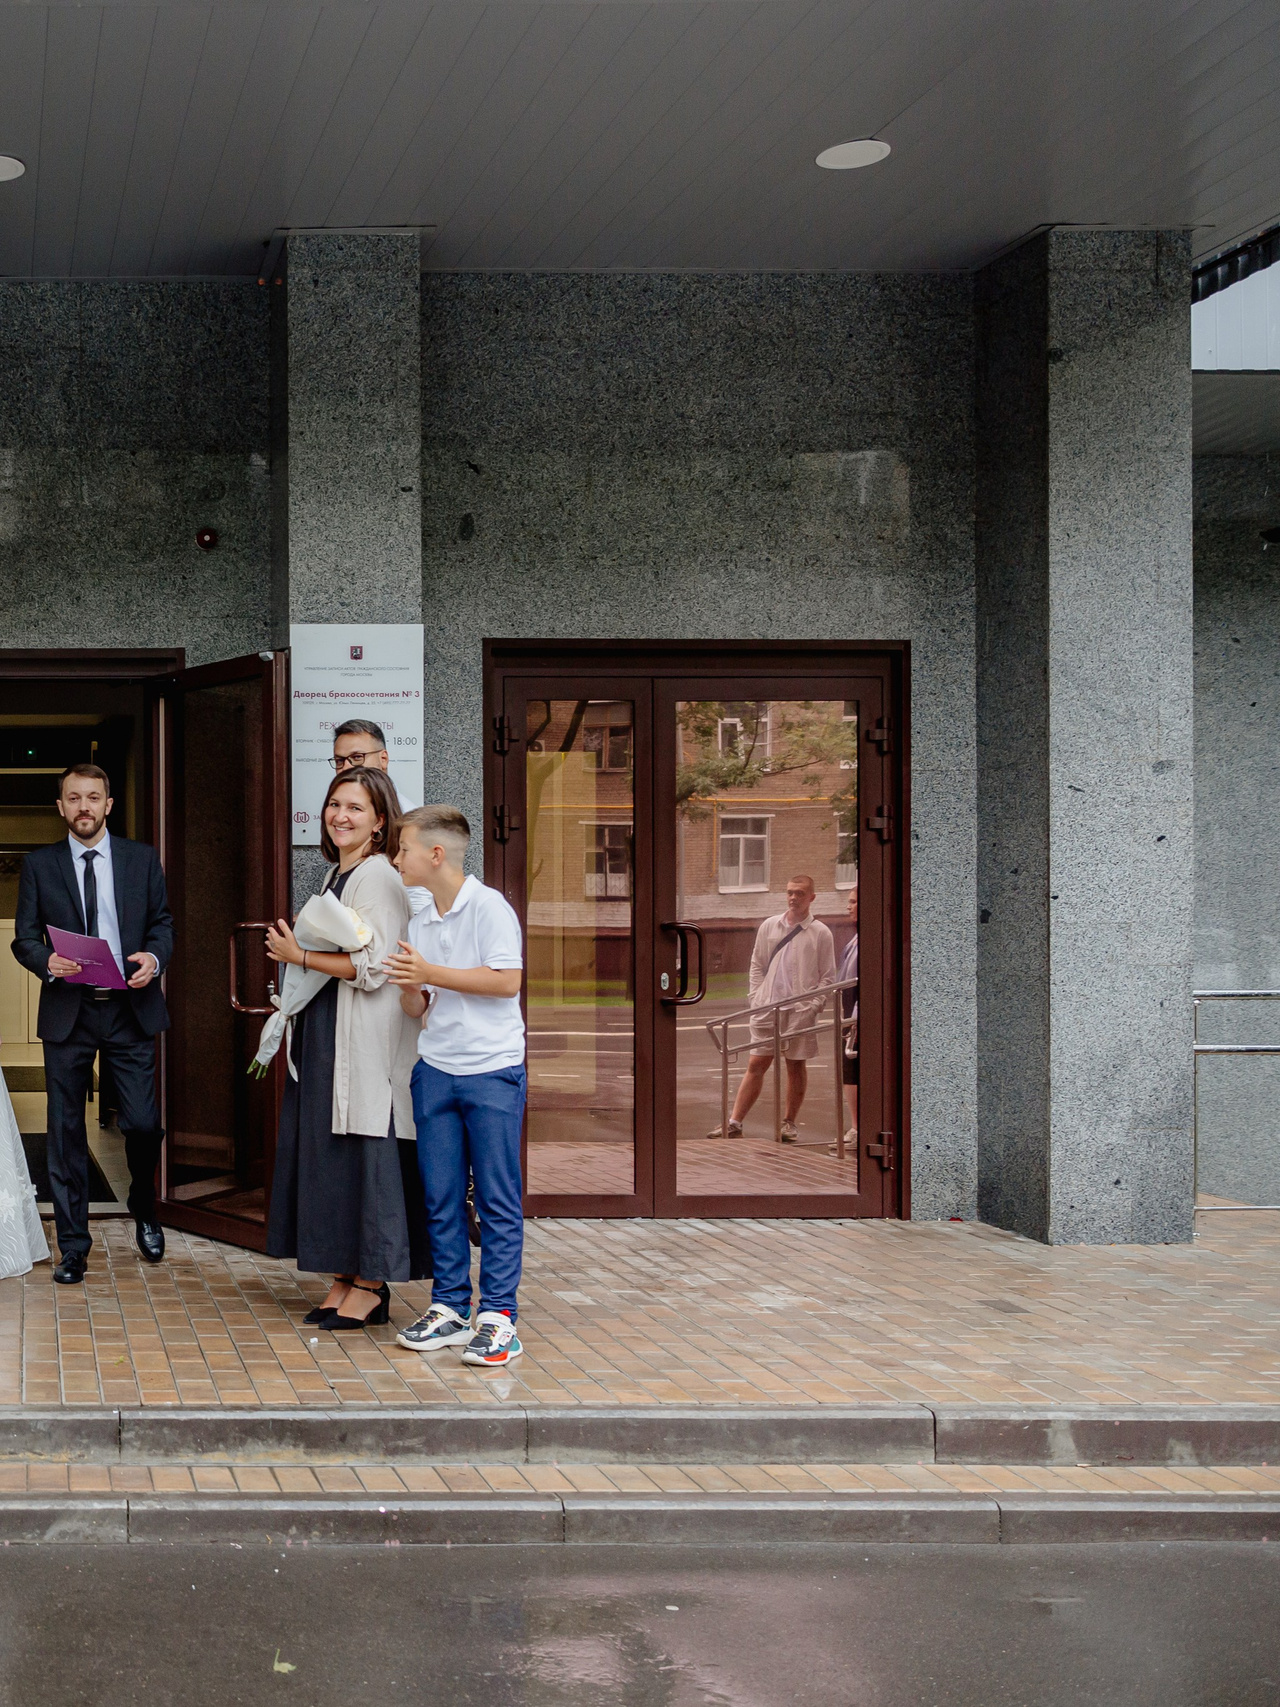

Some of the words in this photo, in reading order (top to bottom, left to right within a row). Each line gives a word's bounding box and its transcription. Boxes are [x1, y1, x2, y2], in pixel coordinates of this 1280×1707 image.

[293, 690, 327, 699] Дворец
[329, 690, 400, 699] бракосочетания
[414, 690, 420, 698] 3
[393, 736, 418, 745] 18:00
